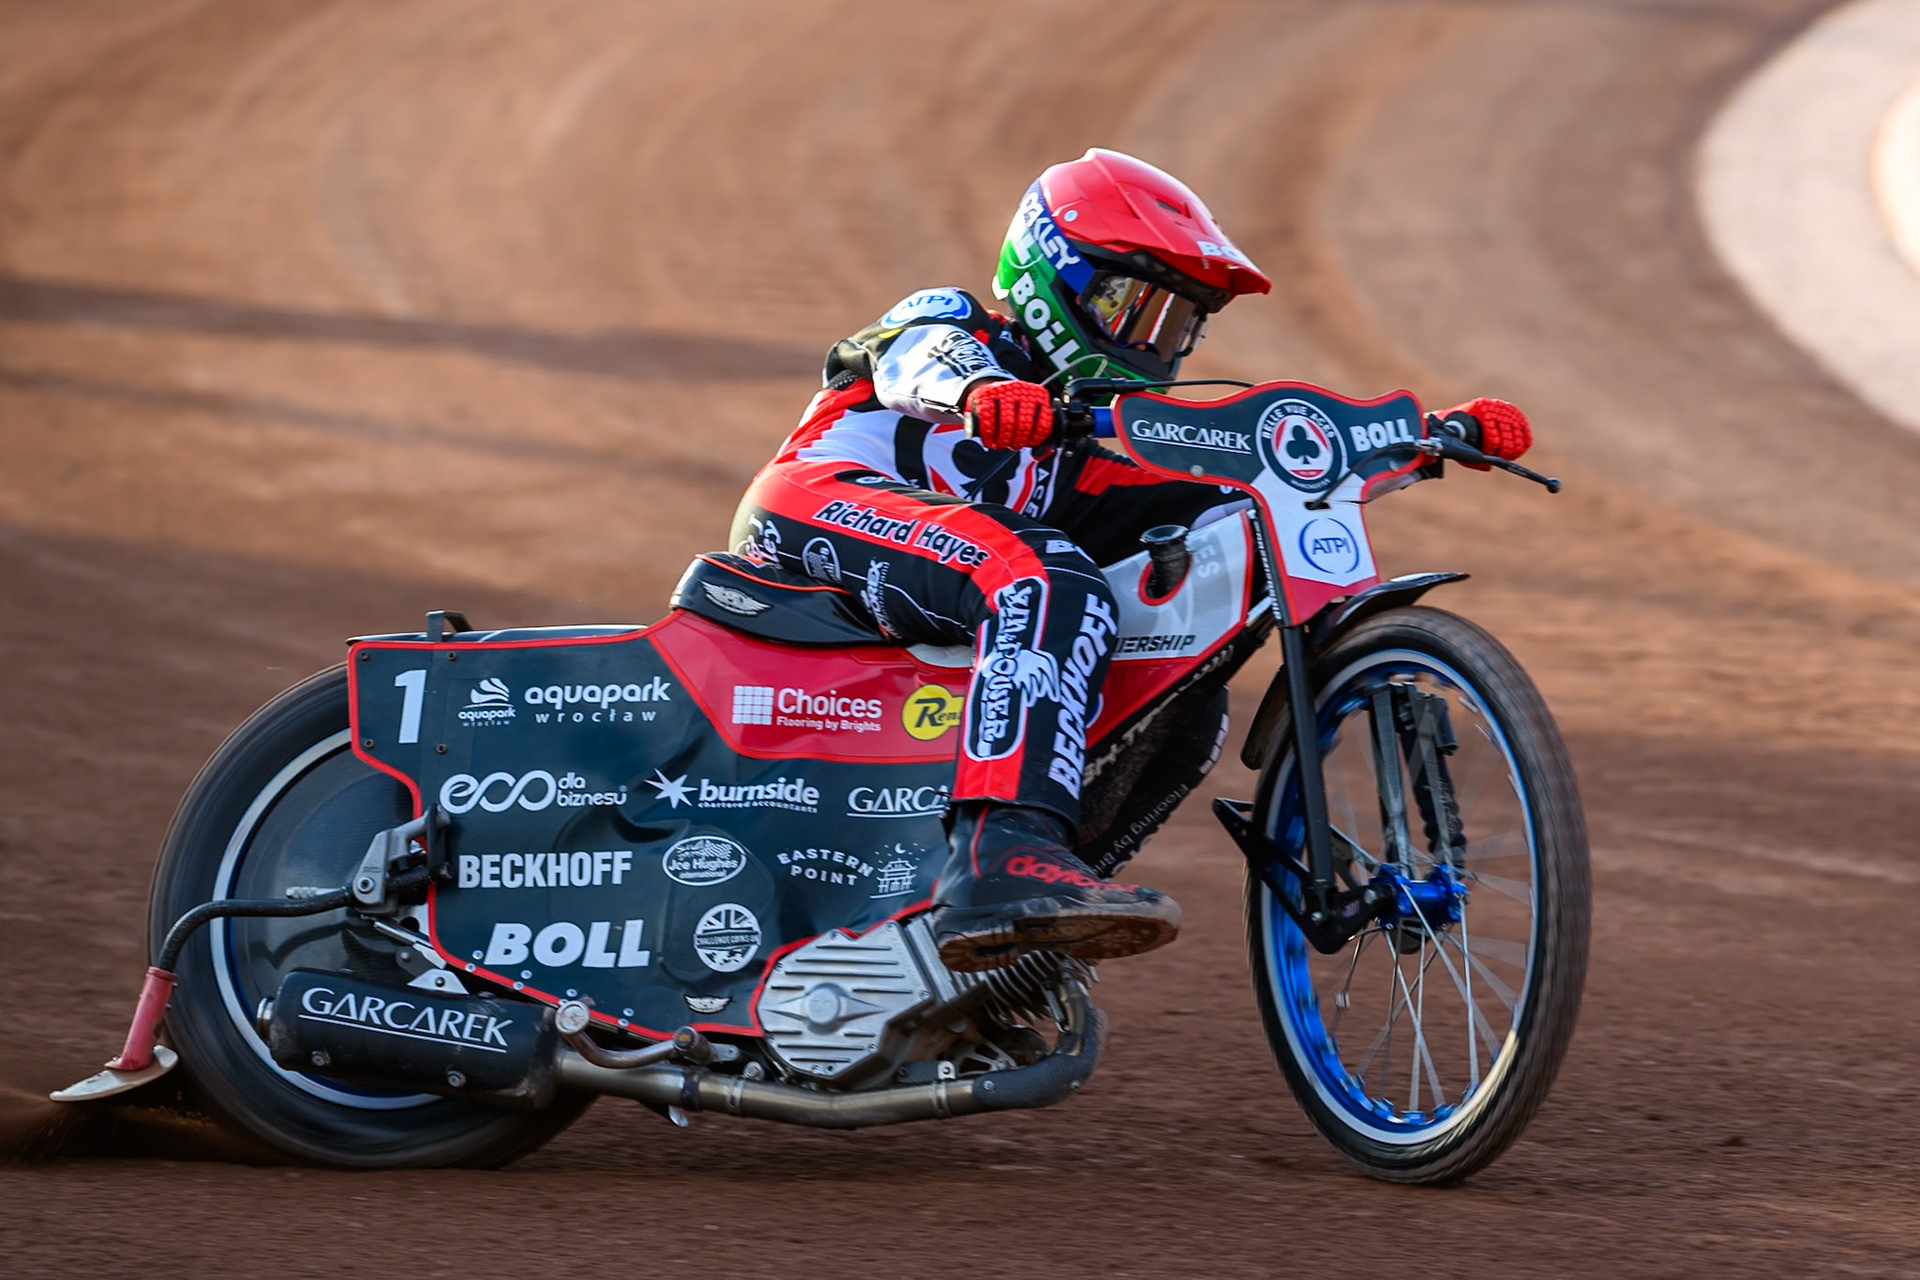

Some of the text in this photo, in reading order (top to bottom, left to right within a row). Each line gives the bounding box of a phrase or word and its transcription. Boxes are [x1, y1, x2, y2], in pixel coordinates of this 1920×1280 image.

[1022, 191, 1081, 271] OAKLEY
[1131, 419, 1252, 451] GARCAREK
[1261, 404, 1335, 439] BELLE VUE ACES
[1349, 418, 1415, 452] BOLL
[812, 499, 916, 545] Richard
[914, 523, 992, 569] Hayes
[1312, 536, 1352, 555] ATPI
[394, 669, 427, 744] 1
[523, 676, 671, 710] aquapark
[778, 688, 882, 719] Choices
[1048, 592, 1118, 800] BECKHOFF
[457, 706, 517, 721] aquapark
[776, 716, 882, 733] Flooring by Brights
[557, 772, 586, 789] dla
[698, 777, 820, 806] burnside
[458, 851, 633, 889] BECKHOFF
[668, 857, 739, 871] Joe Hughes
[776, 848, 874, 878] EASTERN
[790, 864, 858, 886] POINT
[483, 918, 650, 968] BOLL
[301, 986, 513, 1047] GARCAREK
